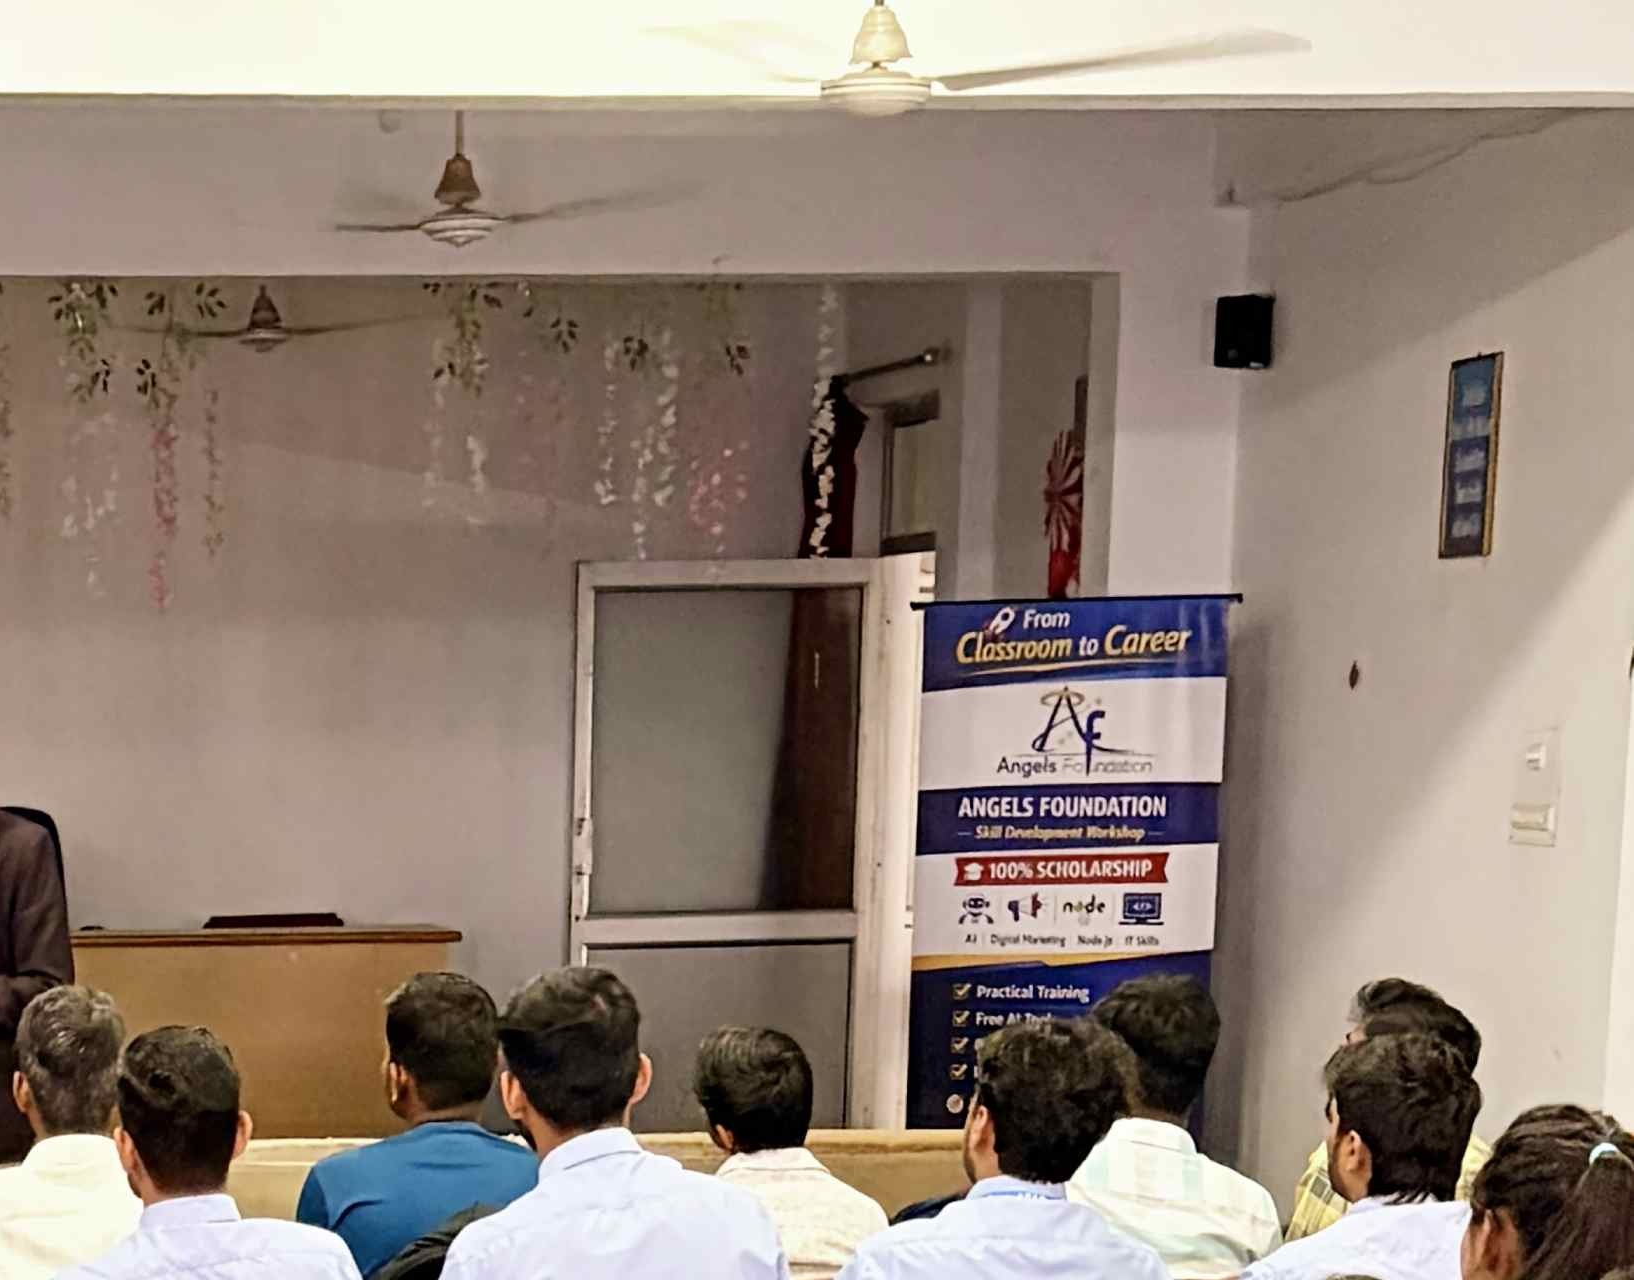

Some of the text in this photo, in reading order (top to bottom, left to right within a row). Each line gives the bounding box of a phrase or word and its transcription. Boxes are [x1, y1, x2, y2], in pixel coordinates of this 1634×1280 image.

[1023, 609, 1070, 629] From
[956, 624, 1192, 663] Classroom to Career
[997, 756, 1057, 778] Angels
[958, 795, 1167, 818] ANGELS FOUNDATION
[975, 824, 1145, 842] Skill Development Workshop
[990, 859, 1153, 880] 100% SCHOLARSHIP
[976, 984, 1090, 1004] Practical Training
[975, 1012, 1005, 1026] Free
